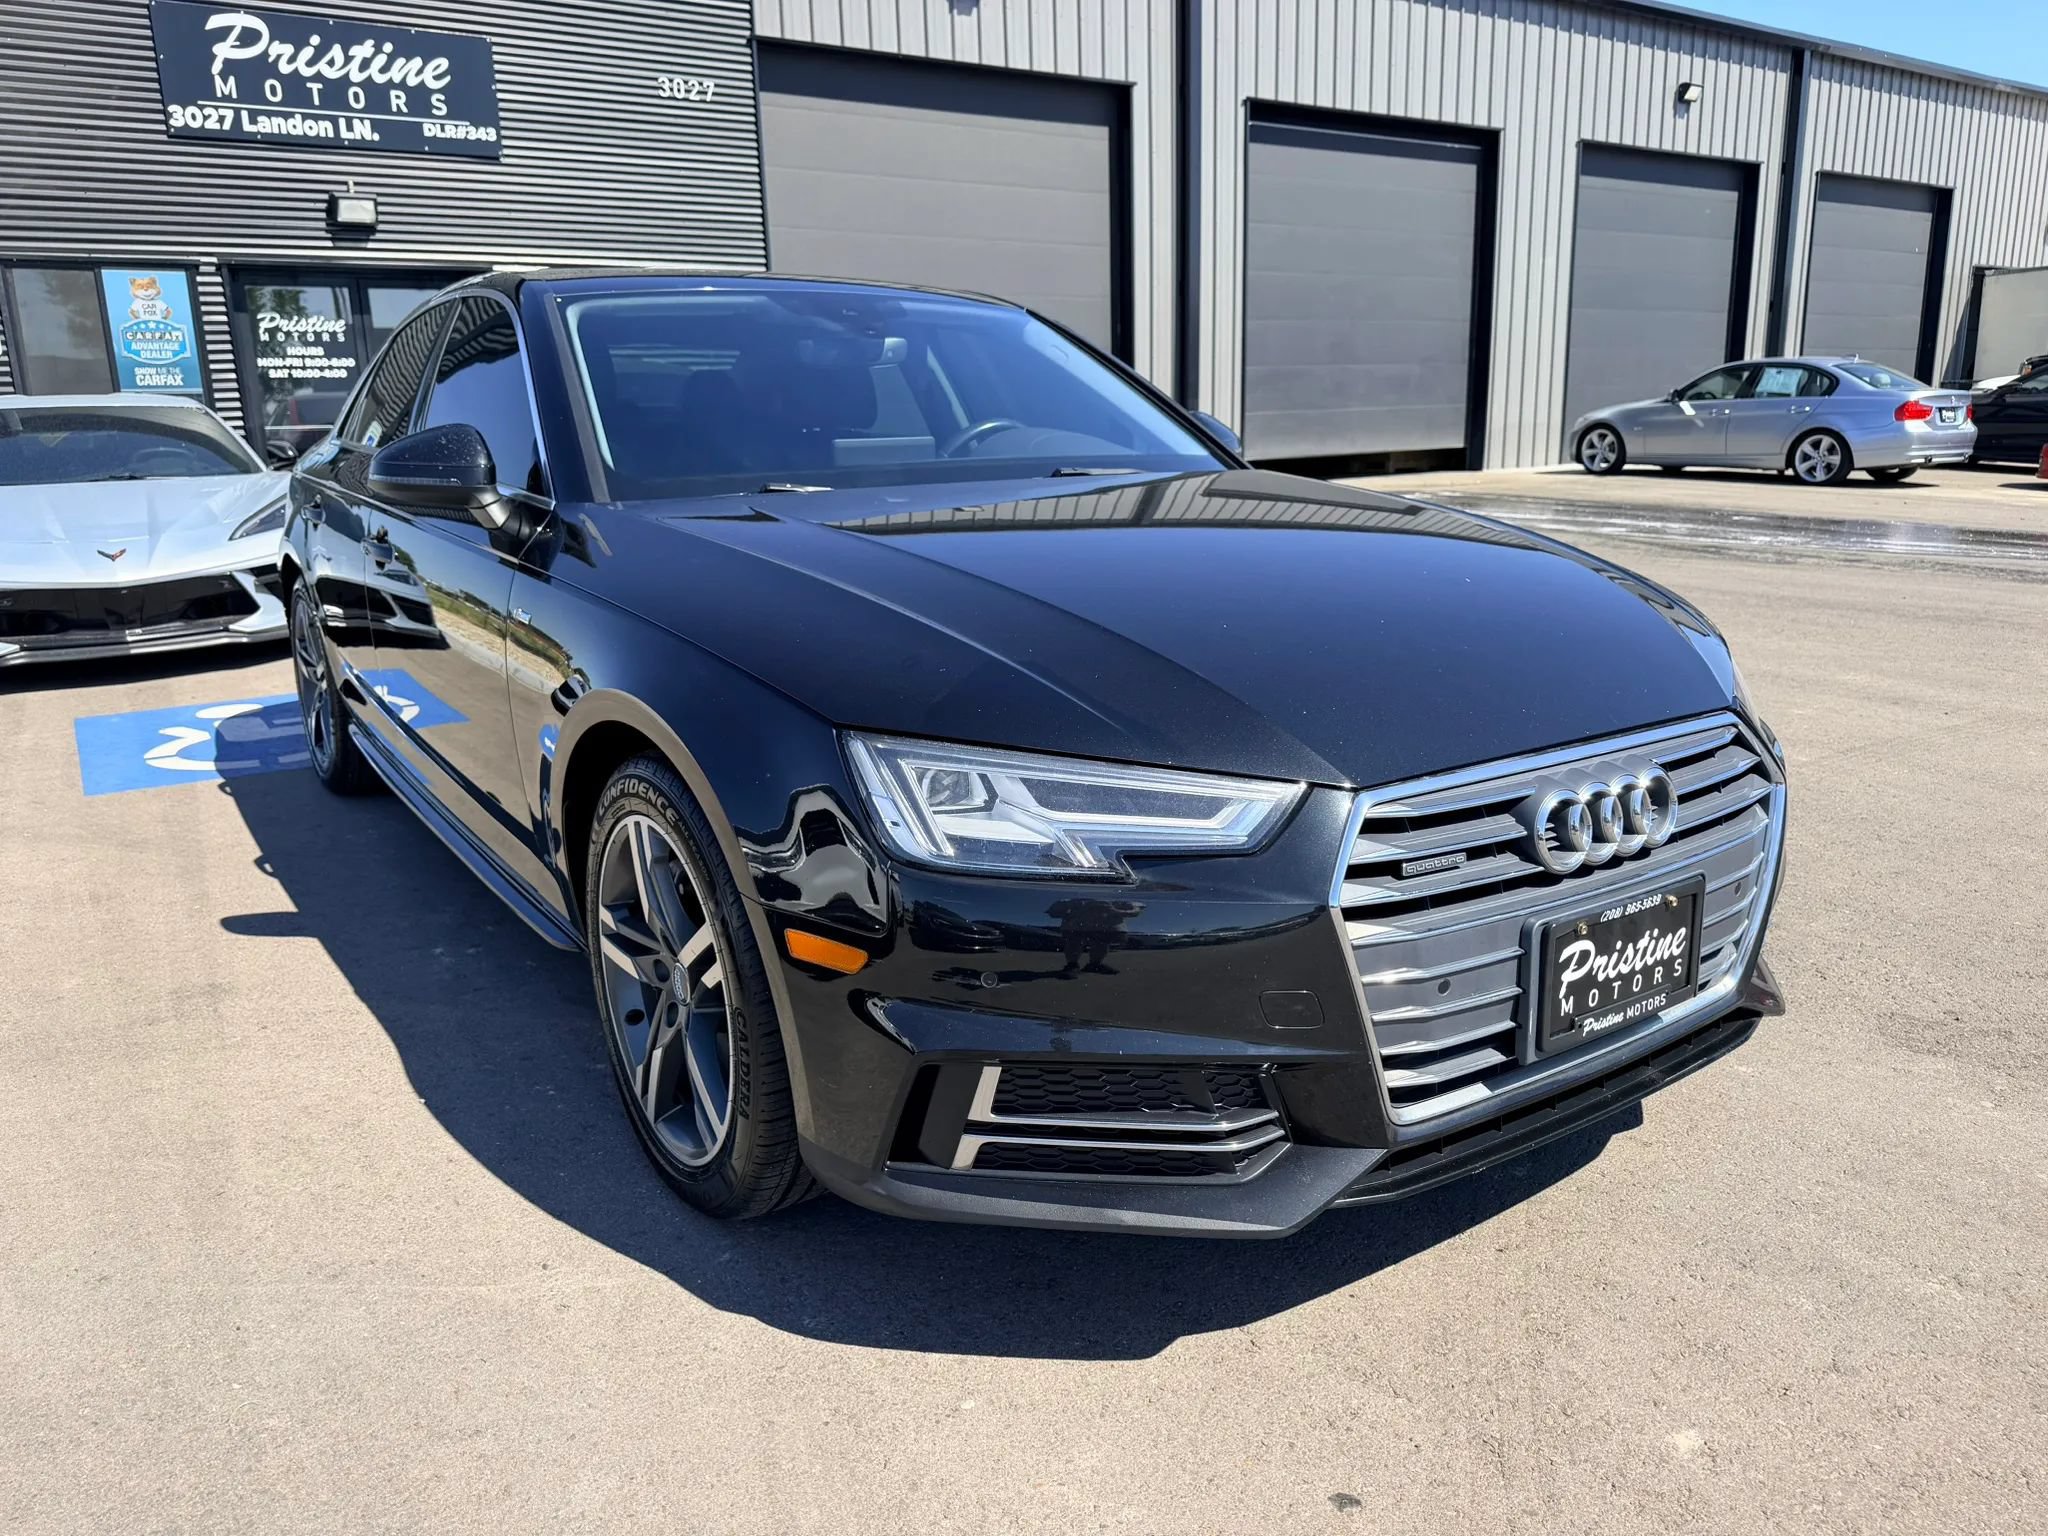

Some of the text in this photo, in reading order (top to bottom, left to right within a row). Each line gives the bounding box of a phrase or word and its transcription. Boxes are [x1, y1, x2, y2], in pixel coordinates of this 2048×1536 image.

[205, 13, 451, 90] Pristine
[214, 74, 449, 117] MOTORS
[657, 76, 715, 103] 3027
[167, 104, 380, 141] 3027 Landon LN.
[422, 122, 497, 142] DLR#343
[256, 311, 347, 333] Pristine
[126, 331, 183, 342] CARFAX
[131, 341, 180, 351] ADVANTAGE
[259, 331, 345, 342] MOTORS
[140, 350, 173, 359] DEALER
[286, 346, 325, 356] HOURS
[134, 366, 157, 375] SHOW
[256, 357, 304, 368] MON-FRI
[135, 374, 184, 387] CARFAX
[268, 368, 290, 379] SAT
[598, 777, 680, 827] CONFIDENCE
[1405, 855, 1466, 874] quattro
[1600, 905, 1624, 923] (208)
[1558, 927, 1687, 999] Pristine
[1560, 958, 1683, 1017] MOTORS
[1582, 993, 1667, 1037] Pristine MOTORS
